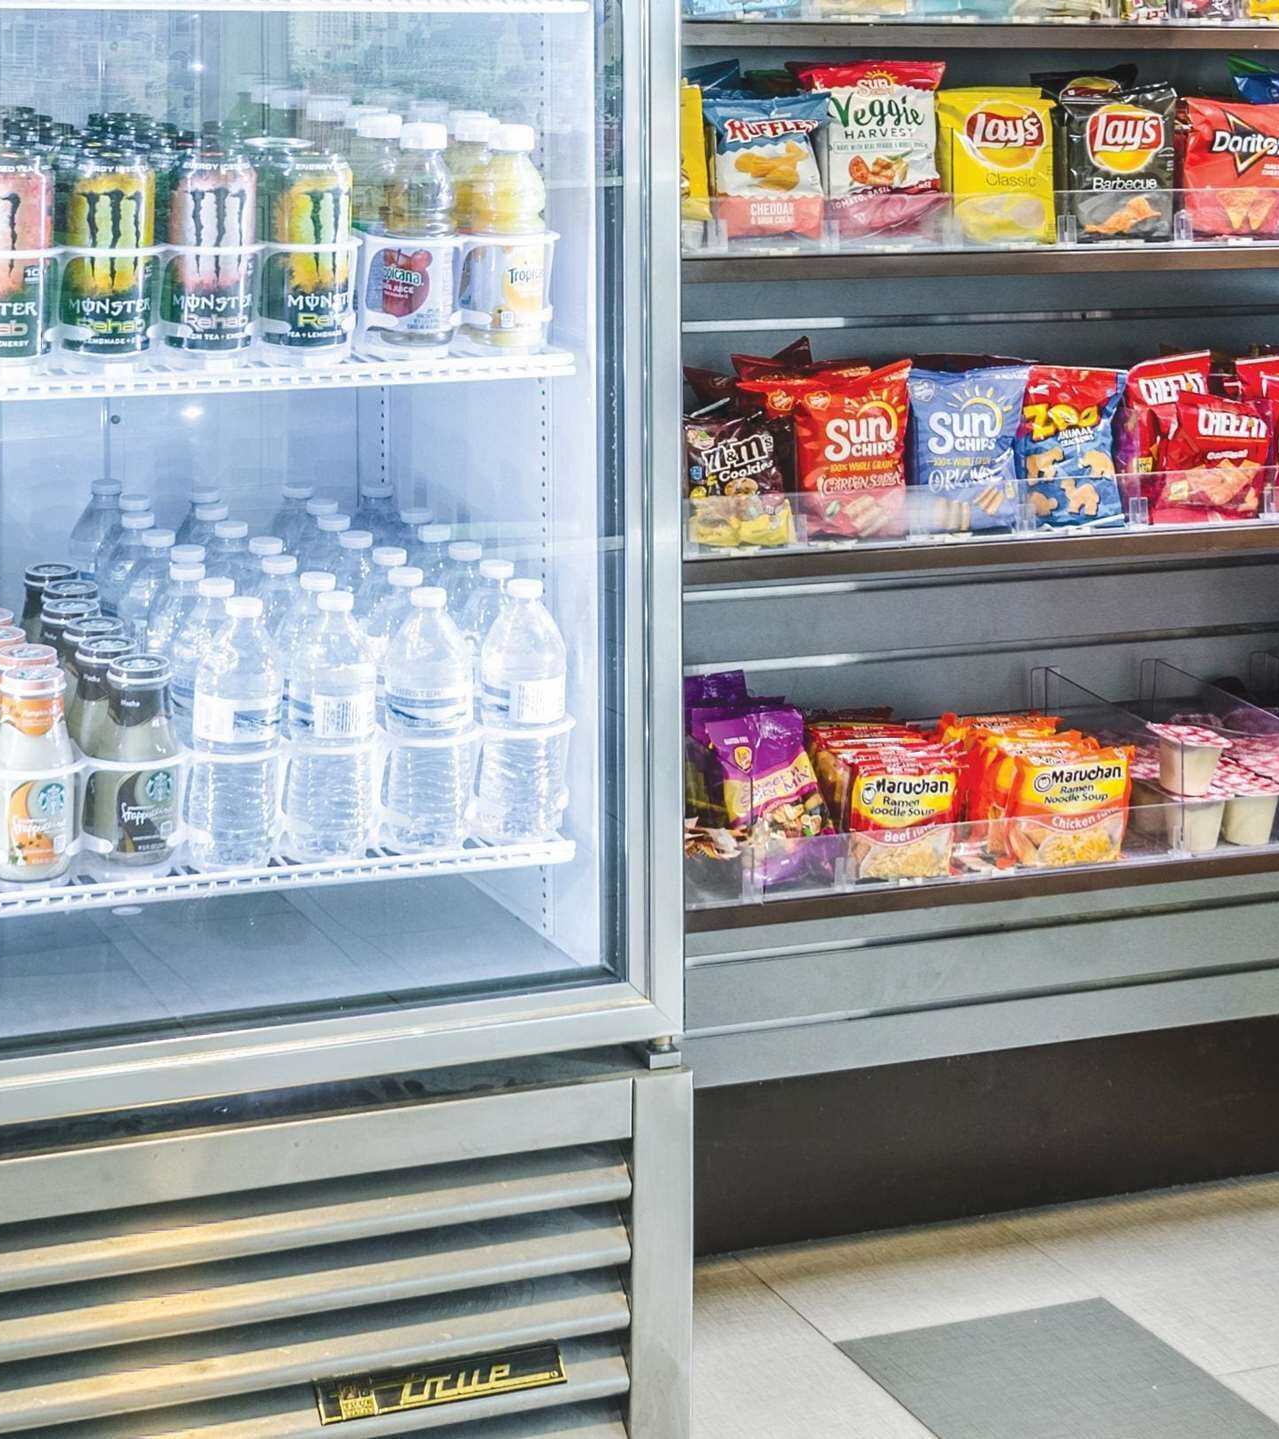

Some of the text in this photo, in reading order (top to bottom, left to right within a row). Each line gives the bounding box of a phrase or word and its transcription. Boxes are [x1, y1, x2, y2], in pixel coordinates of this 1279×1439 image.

[830, 93, 924, 129] Veggie
[843, 128, 914, 140] HARVEST
[973, 112, 1040, 148] Lay's
[1094, 114, 1159, 152] Lay's
[985, 172, 1037, 188] Classic
[1092, 176, 1158, 192] Barbecue
[750, 202, 794, 216] CHEDDAR
[824, 413, 899, 461] Sun
[927, 410, 999, 454] Sun
[851, 439, 896, 457] CHIPS
[955, 436, 996, 452] CHIPS
[719, 459, 775, 482] Cookies
[1051, 765, 1122, 784] Maruchan
[875, 776, 949, 796] Maruchan
[1060, 783, 1095, 794] Ramen
[882, 797, 920, 808] Ramen
[1044, 791, 1109, 805] Noodle Soup
[908, 806, 934, 817] Soup
[1051, 812, 1096, 829] Chicken
[883, 829, 914, 843] Beef
